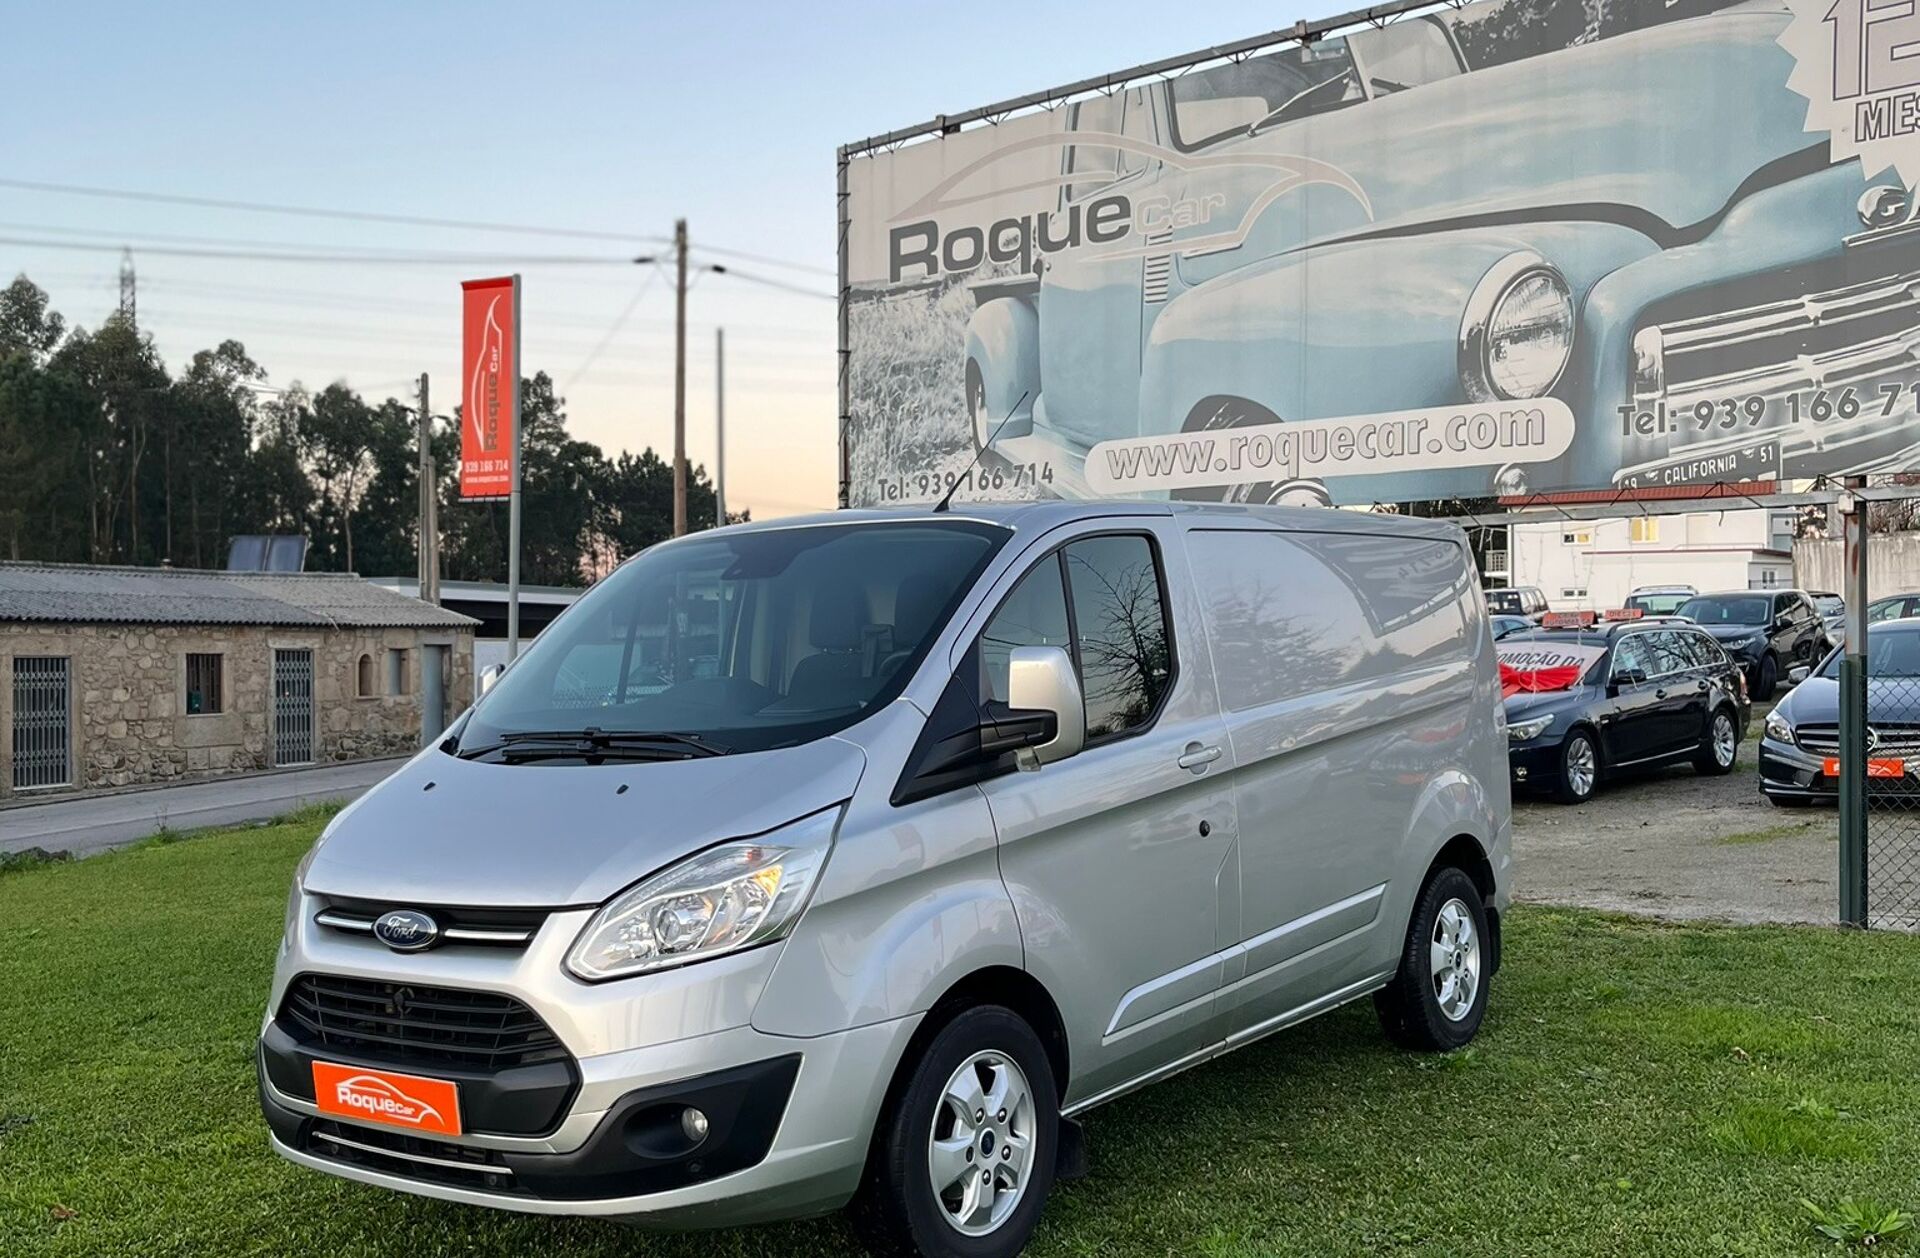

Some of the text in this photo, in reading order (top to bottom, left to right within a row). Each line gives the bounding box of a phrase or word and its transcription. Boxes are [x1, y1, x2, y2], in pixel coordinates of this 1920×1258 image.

[1617, 402, 1677, 436] Tel:
[1694, 396, 1767, 430] 939
[1786, 388, 1860, 423] 166
[1105, 407, 1545, 479] www.roquecar.com
[494, 459, 509, 471] 714
[878, 462, 1054, 501] Tel: 939 166 714
[1664, 454, 1737, 485] CALIFORNIA
[1760, 445, 1774, 462] 51
[384, 916, 418, 939] Ford
